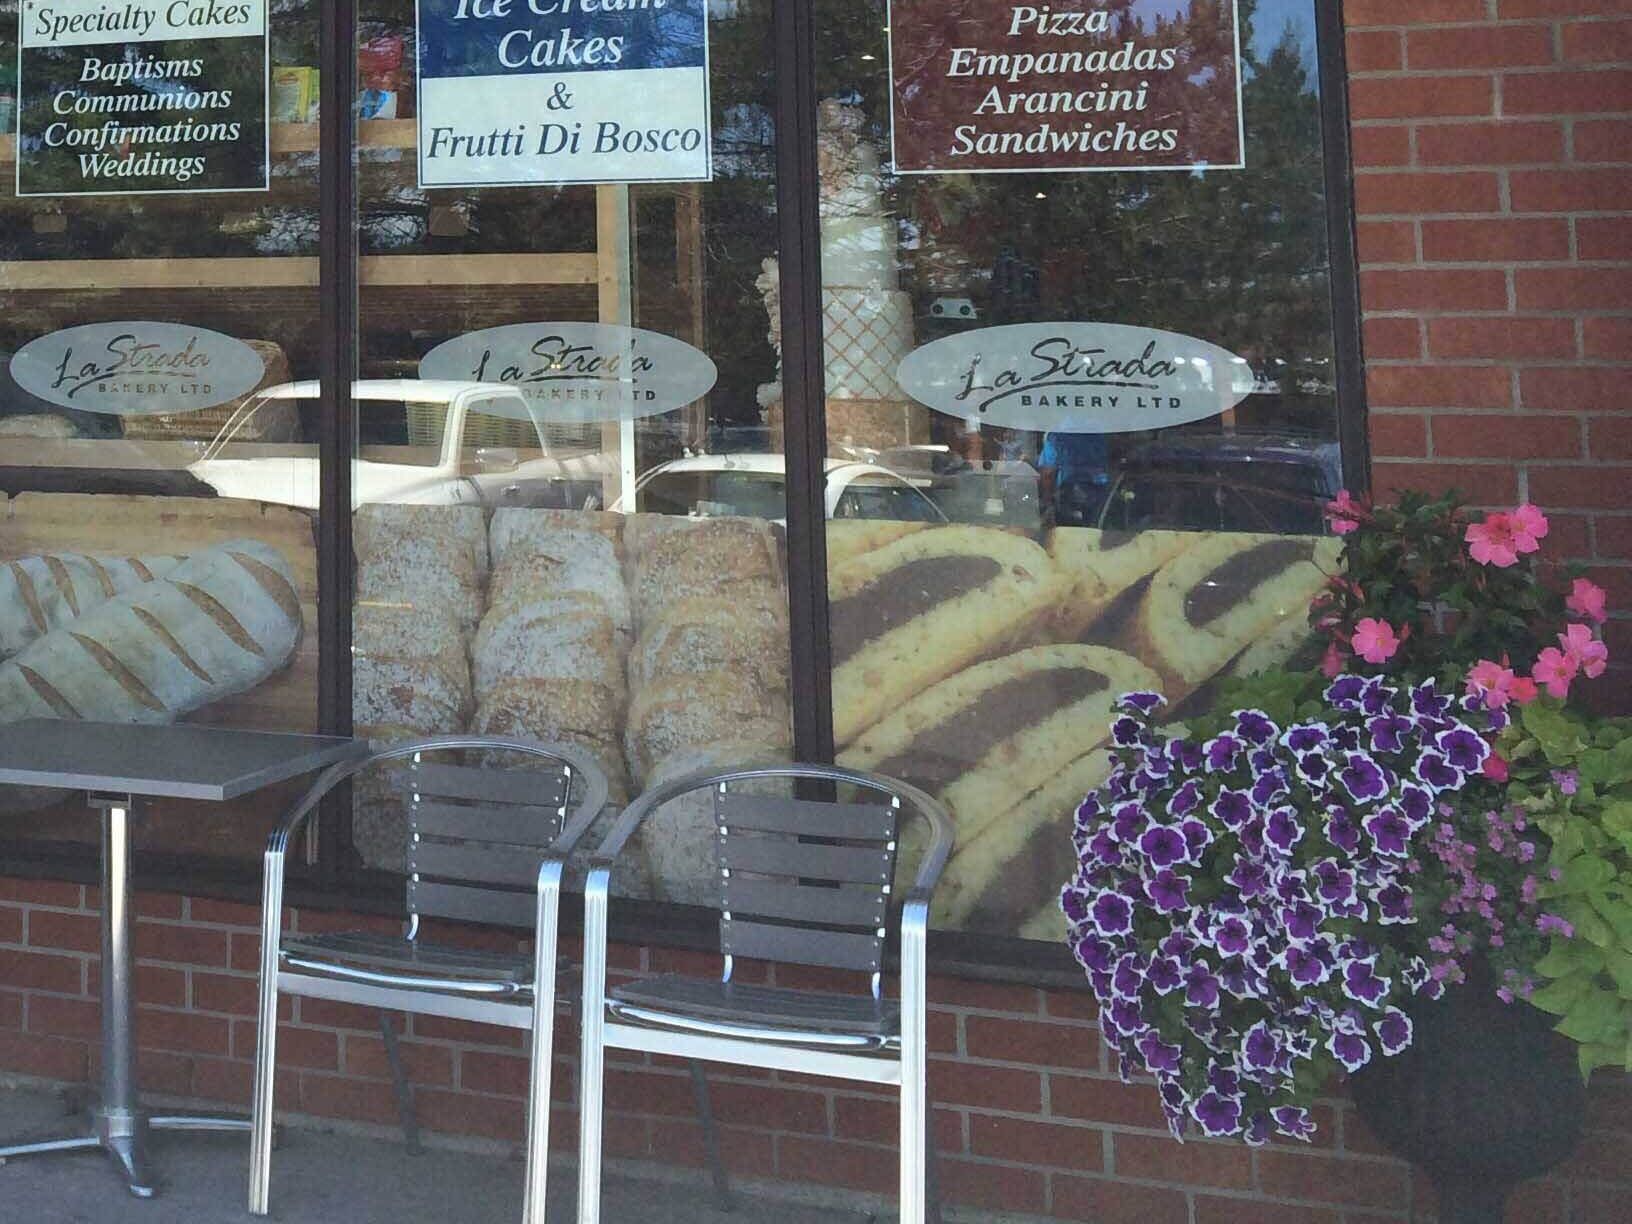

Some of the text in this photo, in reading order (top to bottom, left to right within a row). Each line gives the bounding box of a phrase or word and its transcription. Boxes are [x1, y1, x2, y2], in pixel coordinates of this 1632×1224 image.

[35, 0, 251, 41] Specialty Cakes
[1006, 4, 1109, 36] Pizza
[497, 27, 624, 68] Cakes
[945, 42, 1177, 84] Empanadas
[79, 54, 204, 87] Baptisms
[53, 85, 232, 115] Communions
[546, 81, 576, 111] &
[973, 80, 1149, 115] Arancini
[44, 117, 241, 151] Confirmations
[426, 121, 702, 158] Frutti Di Bosco
[950, 121, 1178, 156] Sandwiches
[78, 152, 206, 182] Weddings
[51, 334, 211, 389] La Strada
[955, 337, 1178, 400] La Strada
[98, 383, 212, 395] BAKERY LTD
[619, 390, 657, 401] TD
[1021, 395, 1183, 409] BAKERY LTD
